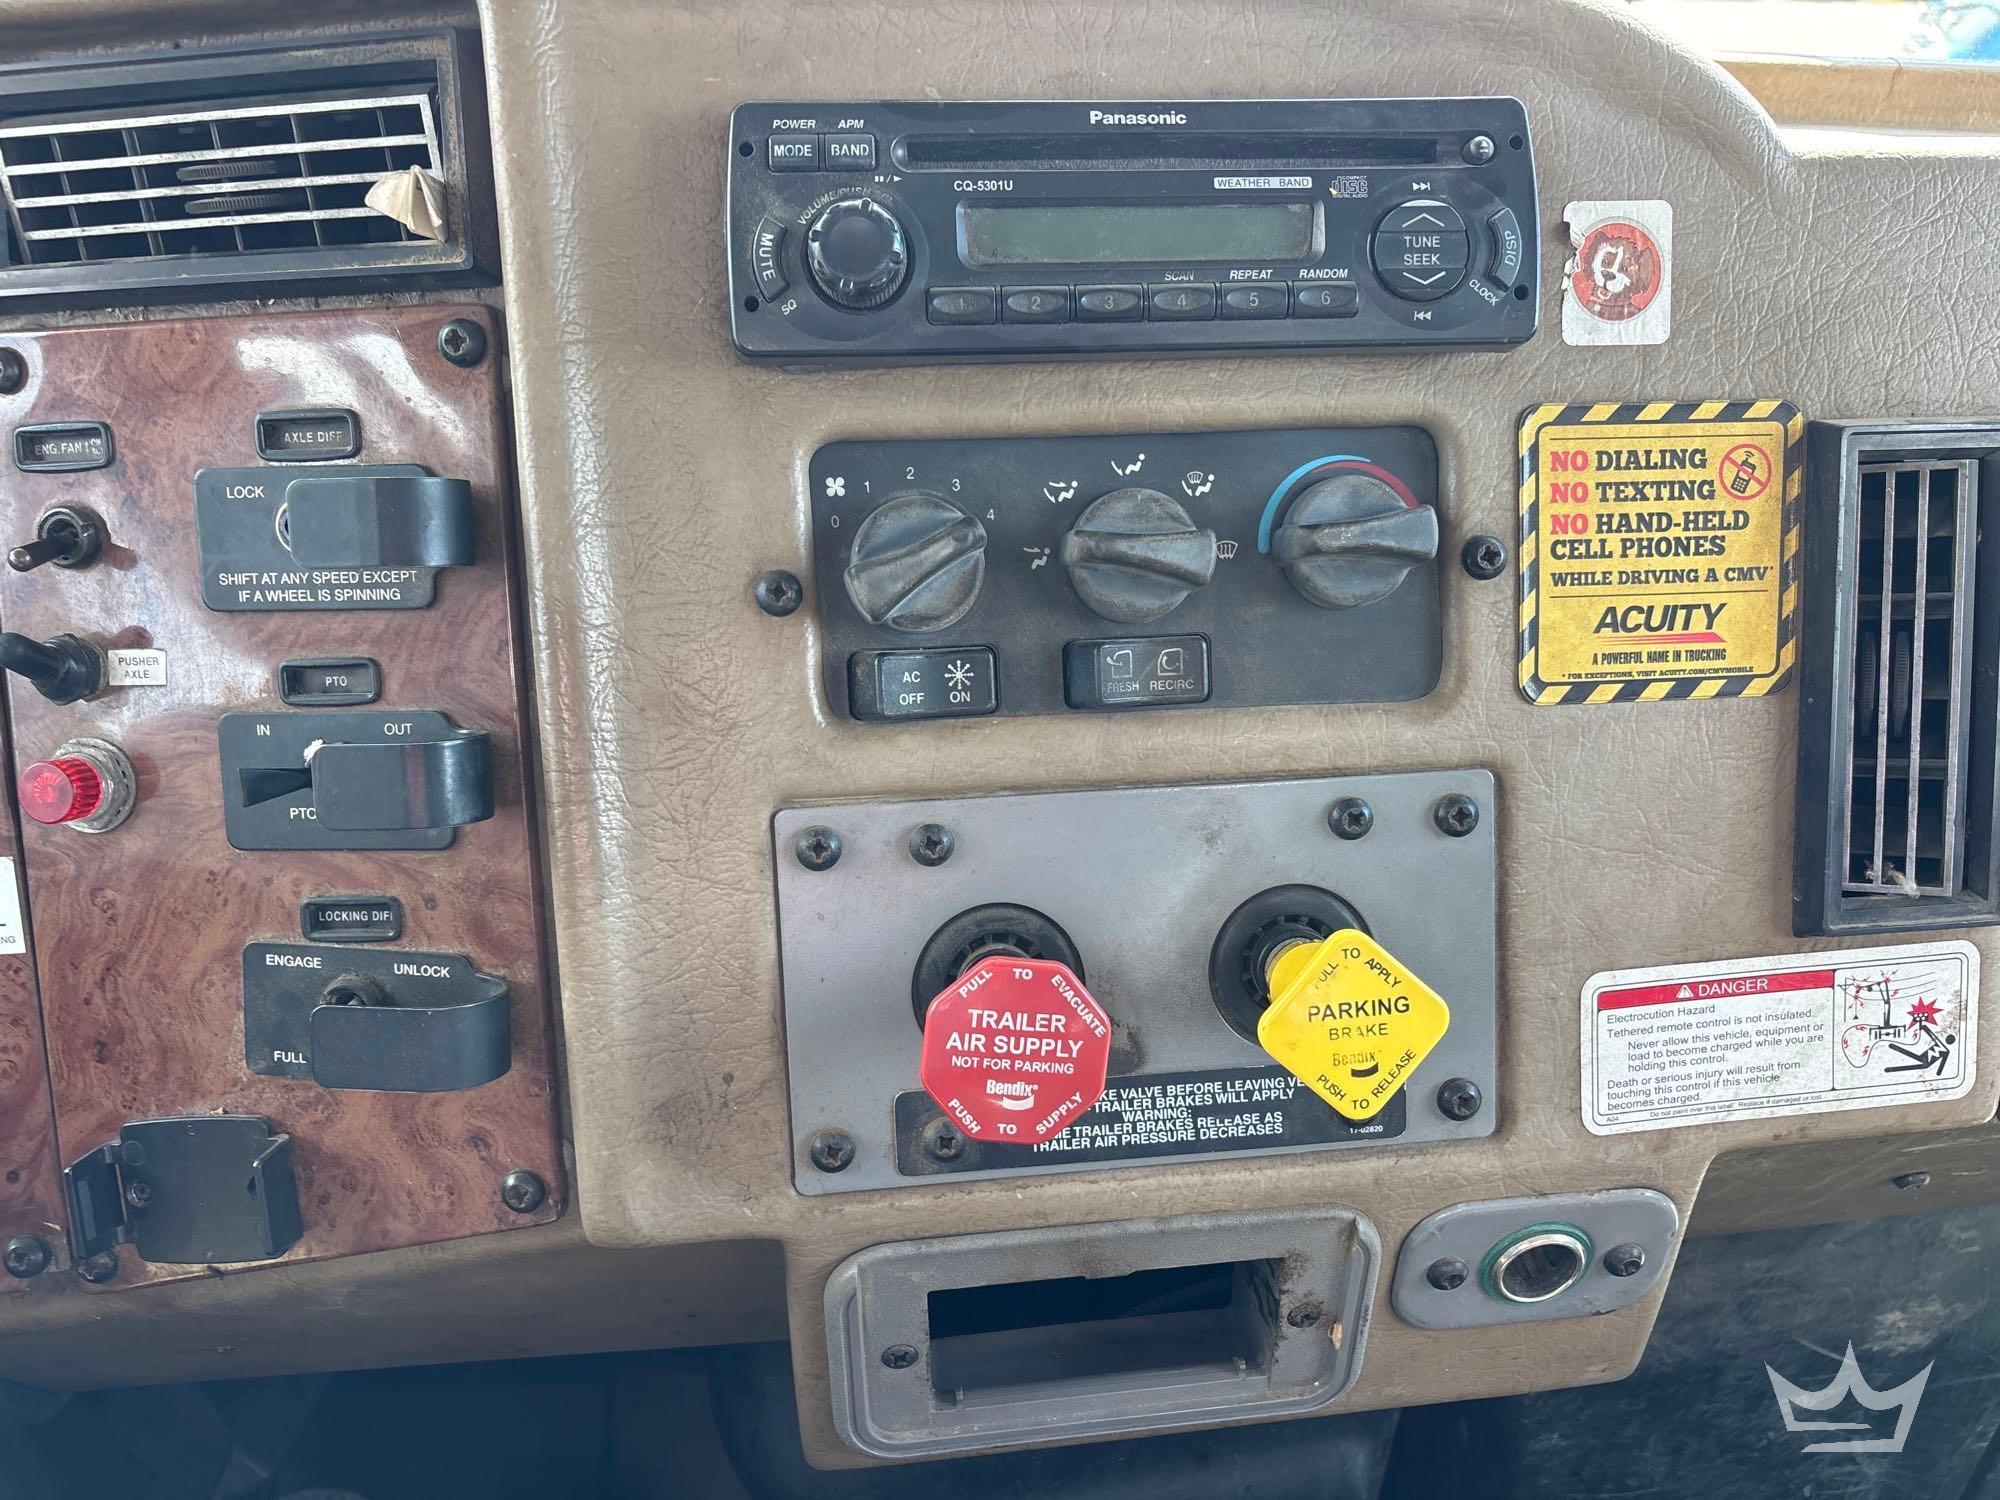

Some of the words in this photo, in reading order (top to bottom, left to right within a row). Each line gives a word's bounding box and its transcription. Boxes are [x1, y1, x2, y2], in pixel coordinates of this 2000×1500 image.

[772, 119, 816, 129] POWER
[837, 119, 864, 129] APM
[1090, 110, 1187, 126] Panasonic
[774, 144, 813, 157] MODE
[831, 144, 869, 156] BAND
[953, 180, 1013, 193] CQ-5301U
[1217, 179, 1271, 188] WEATHER
[1279, 178, 1309, 187] BAND
[1404, 236, 1441, 249] TUNE
[1504, 231, 1516, 267] DISP
[758, 232, 774, 281] MUTE
[1403, 253, 1440, 265] SEEK
[1164, 271, 1195, 281] SCAN
[1229, 269, 1273, 279] REPEAT
[1299, 268, 1348, 278] RANDOM
[1248, 292, 1259, 306] 5
[1320, 291, 1331, 305] 6
[1468, 278, 1499, 306] CLOCK
[781, 299, 798, 316] SQ
[1031, 296, 1041, 310] 2
[1104, 296, 1114, 310] 3
[1176, 293, 1187, 307] 4
[284, 432, 313, 443] AXLE
[317, 431, 343, 442] DIFF
[1549, 450, 1589, 473] NO
[1595, 448, 1708, 472] DIALING
[906, 466, 915, 480] 2
[226, 486, 265, 499] LOCK
[951, 479, 961, 492] 3
[1549, 481, 1589, 504] NO
[1595, 479, 1716, 503] TEXTING
[986, 509, 995, 521] 4
[1549, 513, 1589, 535] NO
[1595, 510, 1750, 534] HAND-HELD
[1549, 538, 1613, 560] CELL
[1619, 535, 1726, 558] PHONES
[218, 572, 258, 585] SHIFT
[261, 572, 278, 584] AT
[280, 572, 309, 584] ANY
[312, 571, 359, 584] SPEED
[362, 570, 418, 583] EXCEPT
[1550, 571, 1613, 587] WHILE
[1617, 568, 1699, 585] DRIVING
[1704, 568, 1720, 583] A
[239, 590, 251, 602] IF
[254, 590, 266, 601] A
[267, 590, 315, 602] WHEEL
[318, 589, 331, 601] IS
[334, 588, 401, 601] SPINNING
[1593, 602, 1728, 634] ACUITY
[118, 656, 160, 667] PUSHER
[1592, 652, 1598, 665] A
[1601, 651, 1644, 665] POWERFUL
[1646, 650, 1669, 663] NAME
[1672, 649, 1682, 663] IN
[1685, 648, 1727, 662] TRUCKING
[124, 668, 150, 680] AXLE
[325, 675, 348, 687] PTO
[902, 671, 921, 683] AC
[1567, 672, 1583, 680] FOR
[1107, 680, 1140, 693] FRESH
[1149, 678, 1194, 691] RECIRC
[899, 692, 925, 706] OFF
[949, 691, 971, 704] ON
[256, 724, 270, 736] IN
[384, 723, 413, 736] OUT
[319, 910, 369, 922] LOCKING
[265, 954, 322, 969] ENGAGE
[1341, 947, 1361, 960] TO
[1364, 958, 1402, 989] APPLY
[394, 963, 451, 978] UNLOCK
[1698, 978, 1768, 997] DANGER
[958, 969, 993, 998] PULL
[1013, 968, 1033, 980] TO
[1051, 974, 1107, 1038] EVACUATE
[1308, 995, 1410, 1023] PARKING
[968, 1008, 1066, 1033] TRAILER
[1607, 1009, 1674, 1025] Electrocution
[1677, 1004, 1715, 1017] Hazard
[1607, 1024, 1654, 1039] Tethered
[1657, 1022, 1693, 1034] remote
[1696, 1017, 1731, 1029] control
[1734, 1015, 1742, 1026] is
[1745, 1013, 1762, 1024] not
[1765, 1008, 1814, 1022] insulated.
[1329, 1023, 1389, 1041] BRAKE
[1628, 1037, 1659, 1051] Never
[1662, 1035, 1689, 1047] allow
[1692, 1030, 1710, 1044] this
[1755, 1023, 1810, 1039] equipment
[1813, 1023, 1824, 1032] or
[945, 1032, 986, 1052] AIR
[993, 1035, 1084, 1058] SUPPLY
[1628, 1050, 1650, 1062] load
[1653, 1049, 1663, 1059] to
[1666, 1044, 1708, 1058] become
[1710, 1039, 1752, 1053] charged
[1755, 1037, 1783, 1048] while
[1785, 1036, 1804, 1048] you
[1806, 1034, 1824, 1043] are
[274, 1050, 307, 1064] FULL
[951, 1055, 981, 1069] NOT
[983, 1058, 1011, 1071] FOR
[1014, 1060, 1075, 1074] PARKING
[1628, 1061, 1666, 1073] holding
[1668, 1056, 1687, 1068] this
[1690, 1054, 1728, 1066] control.
[1316, 1074, 1348, 1101] PUSH
[1351, 1098, 1370, 1111] TO
[1372, 1048, 1417, 1098] RELEASE
[1607, 1077, 1639, 1089] Death
[1641, 1076, 1652, 1085] or
[1654, 1071, 1693, 1084] serious
[1695, 1069, 1723, 1082] injury
[1725, 1065, 1743, 1076] will
[1745, 1062, 1775, 1074] result
[1777, 1060, 1801, 1071] from
[1120, 1086, 1163, 1100] VALVE
[1166, 1082, 1223, 1097] BEFORE
[1226, 1078, 1285, 1093] LEAVING
[1607, 1086, 1651, 1100] touching
[1654, 1083, 1672, 1094] this
[1675, 1080, 1711, 1092] control
[1713, 1077, 1720, 1088] if
[1722, 1075, 1741, 1087] this
[1743, 1073, 1780, 1085] vehicle
[1094, 1099, 1151, 1113] TRAILER
[1156, 1094, 1213, 1109] BRAKES
[1216, 1092, 1242, 1105] WILL
[1245, 1088, 1295, 1103] APPLY
[1607, 1098, 1655, 1111] becomes
[1657, 1093, 1702, 1108] charged.
[948, 1098, 982, 1134] PUSH
[997, 1123, 1017, 1135] TO
[1036, 1091, 1083, 1135] SUPPLY
[1121, 1107, 1192, 1123] WARNING:
[1074, 1124, 1132, 1139] TRAILER
[1136, 1119, 1193, 1134] BRAKES
[1197, 1113, 1262, 1128] RELEASE
[1264, 1112, 1283, 1123] AS
[1094, 1135, 1118, 1148] AIR
[1121, 1130, 1196, 1146] PRESSURE
[1199, 1123, 1283, 1140] DECREASES
